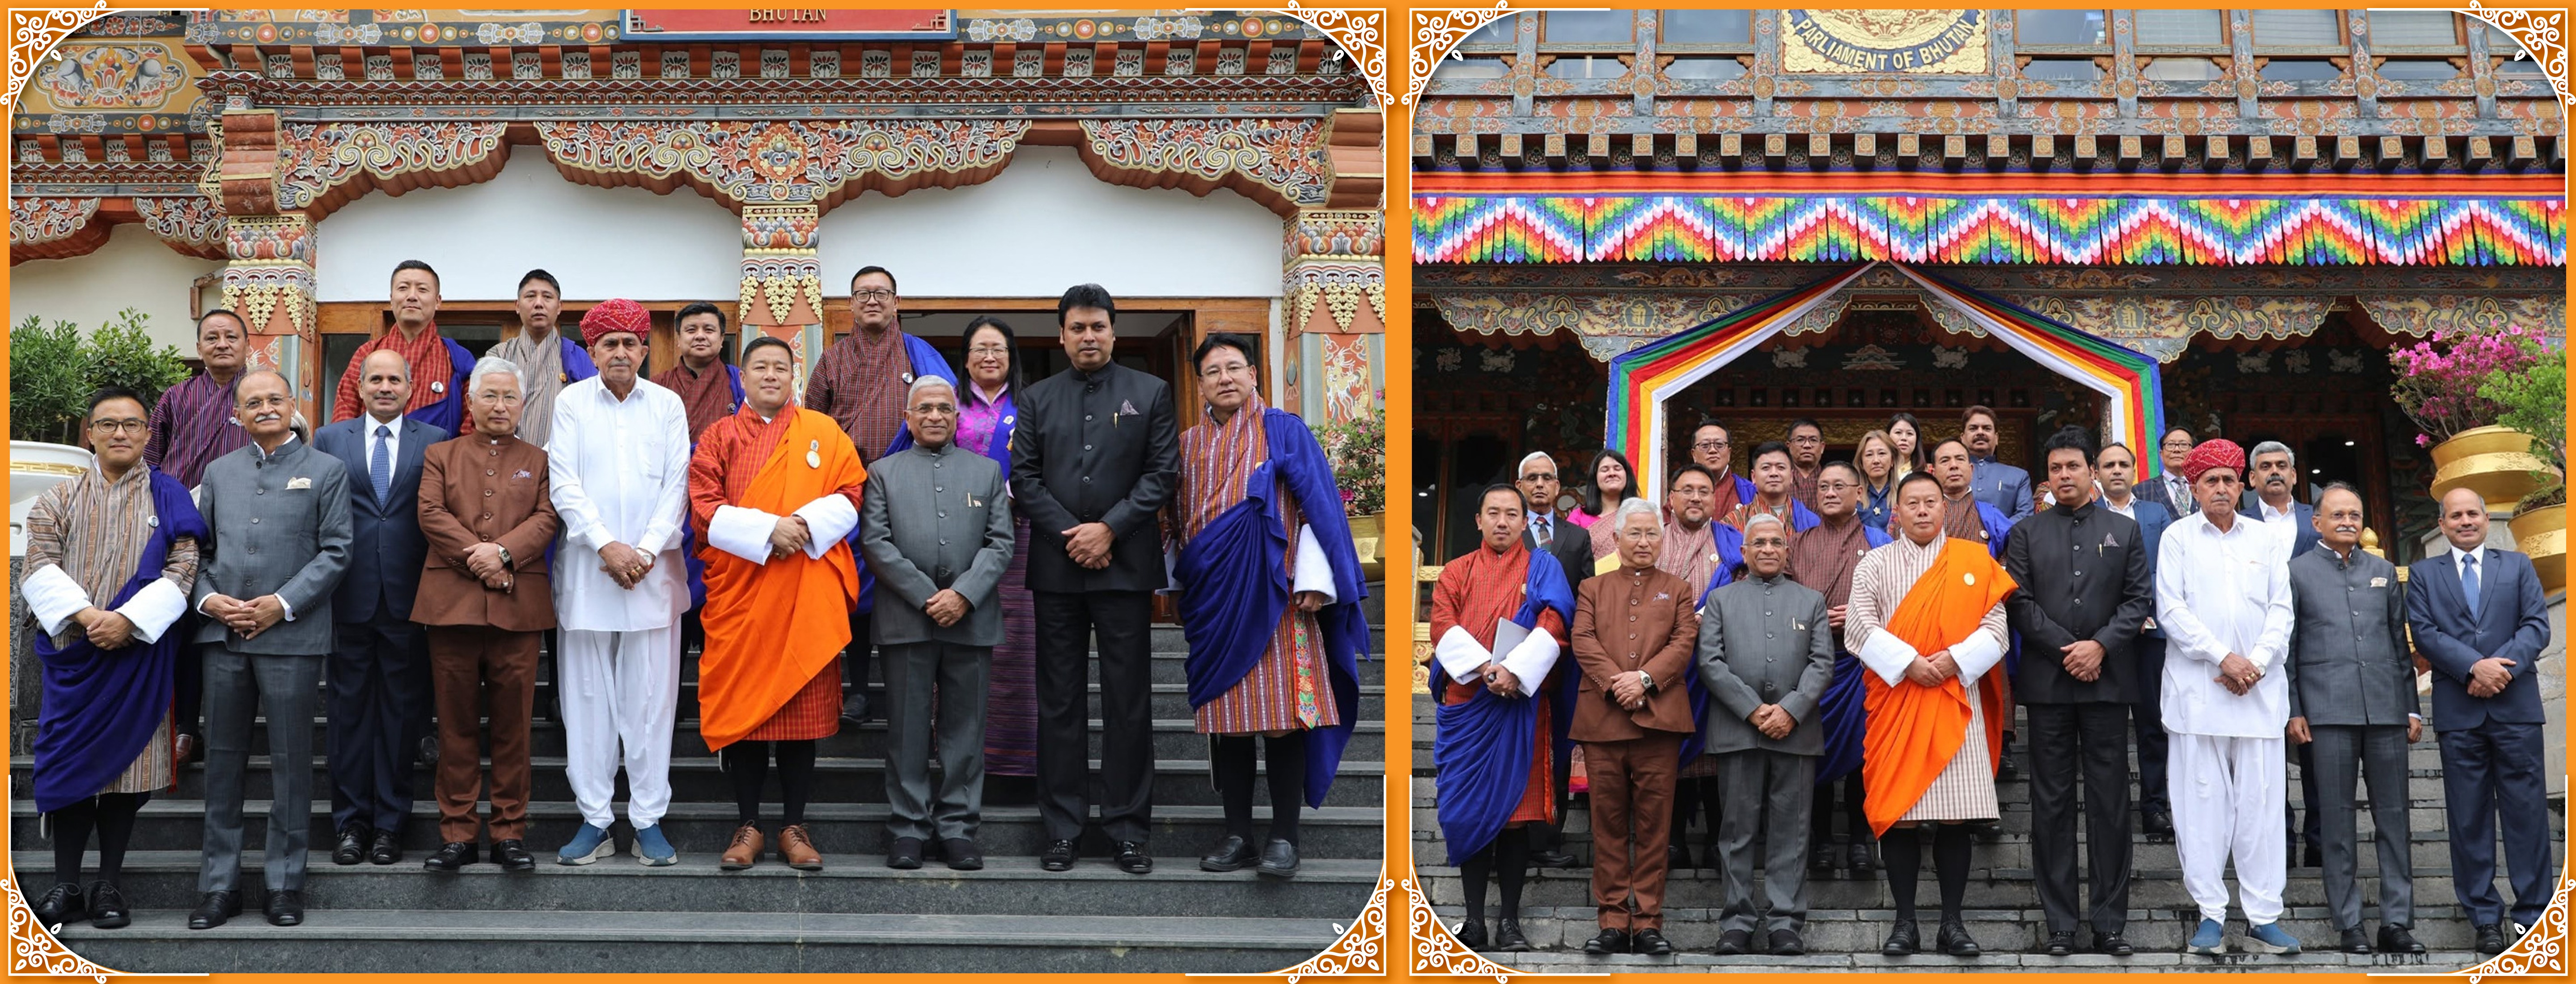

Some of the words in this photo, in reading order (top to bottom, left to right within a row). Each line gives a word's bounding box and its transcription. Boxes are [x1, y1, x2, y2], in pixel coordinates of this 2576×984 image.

[1795, 19, 1888, 70] PARLIAMENT
[1893, 51, 1913, 69] OF
[1919, 19, 1974, 64] BHUTAN
